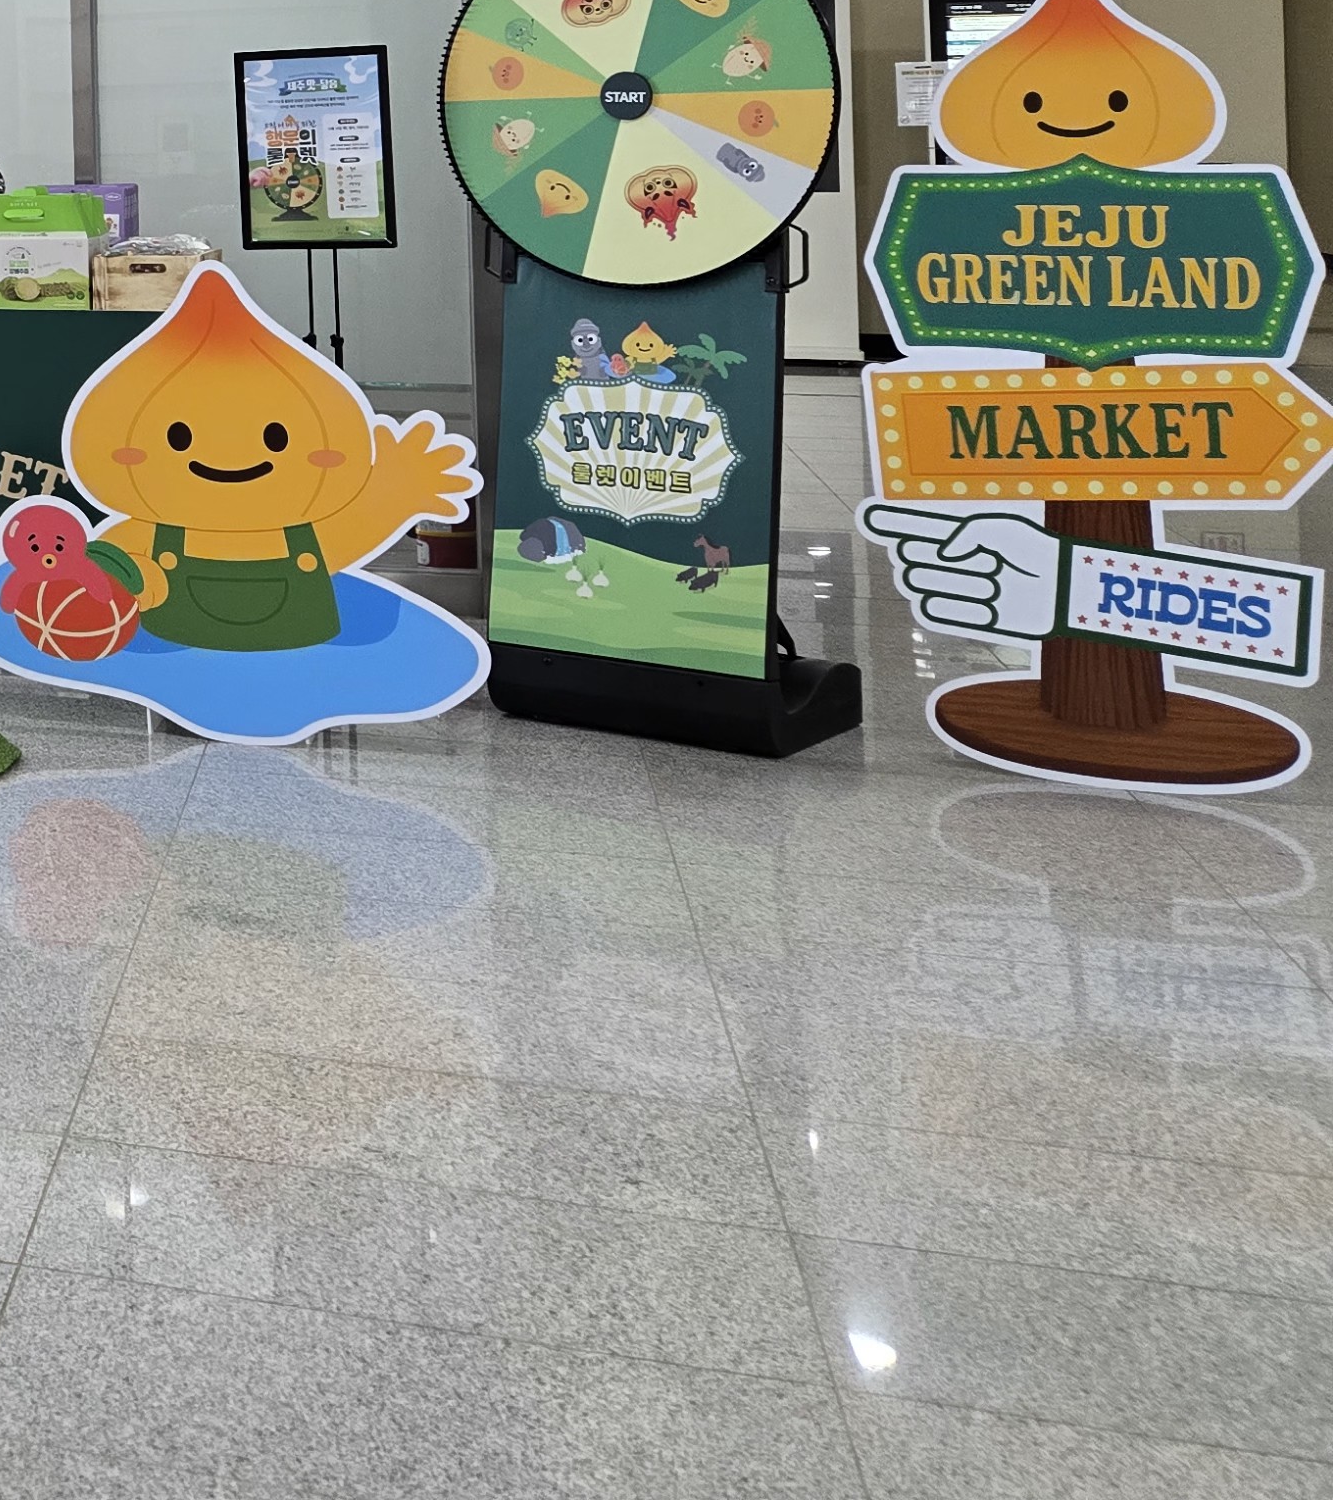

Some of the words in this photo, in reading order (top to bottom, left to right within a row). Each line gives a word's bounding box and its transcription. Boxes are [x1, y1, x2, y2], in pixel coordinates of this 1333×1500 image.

[604, 90, 646, 104] START
[265, 129, 317, 147] 행운의
[1001, 204, 1170, 249] JEJU
[916, 252, 1093, 307] GREEN
[1108, 255, 1262, 311] LAND
[559, 411, 709, 462] EVENT
[946, 401, 1235, 461] MARKET
[1097, 571, 1271, 639] RIDES
